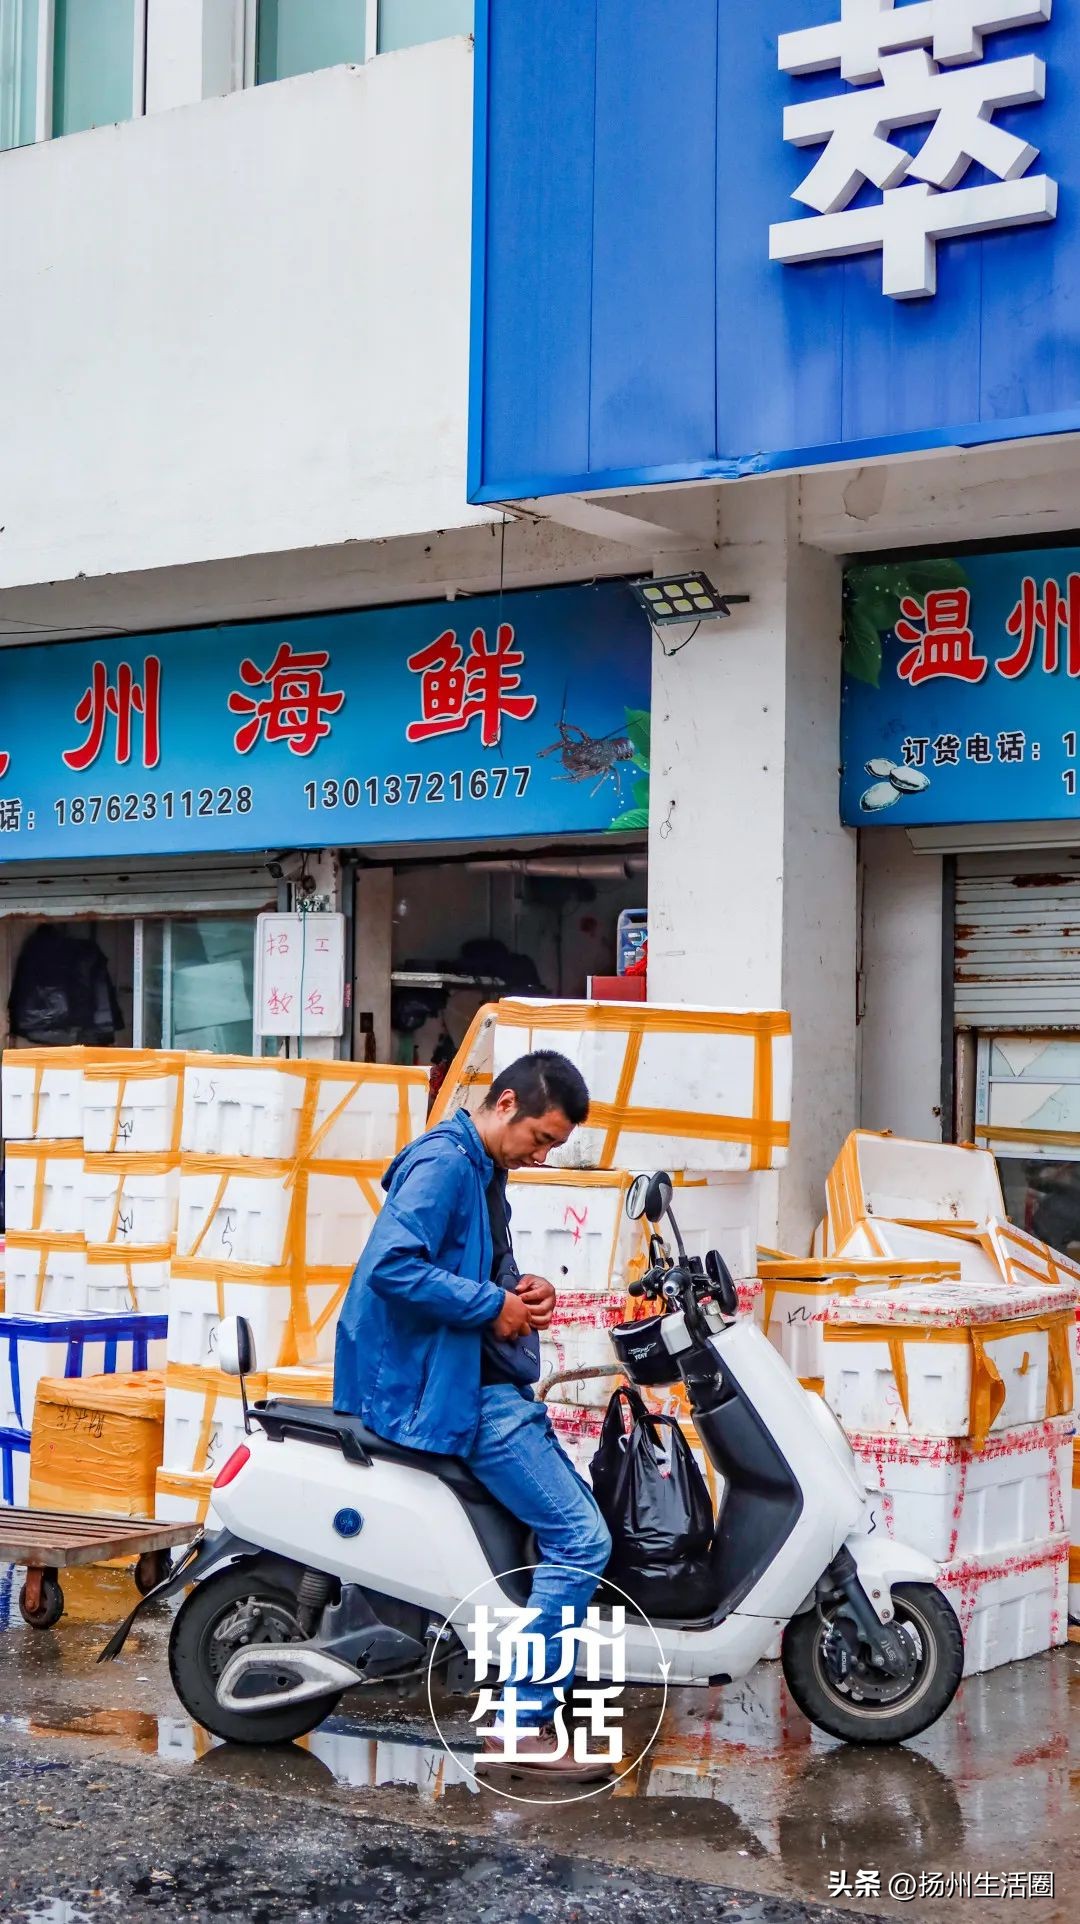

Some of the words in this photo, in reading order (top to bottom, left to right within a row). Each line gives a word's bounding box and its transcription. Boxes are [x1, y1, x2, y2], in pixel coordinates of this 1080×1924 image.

[0, 623, 537, 782] 州海鲜
[902, 731, 1041, 766] 订货电话：
[54, 785, 253, 826] 18762311228
[304, 765, 532, 810] 13013721677
